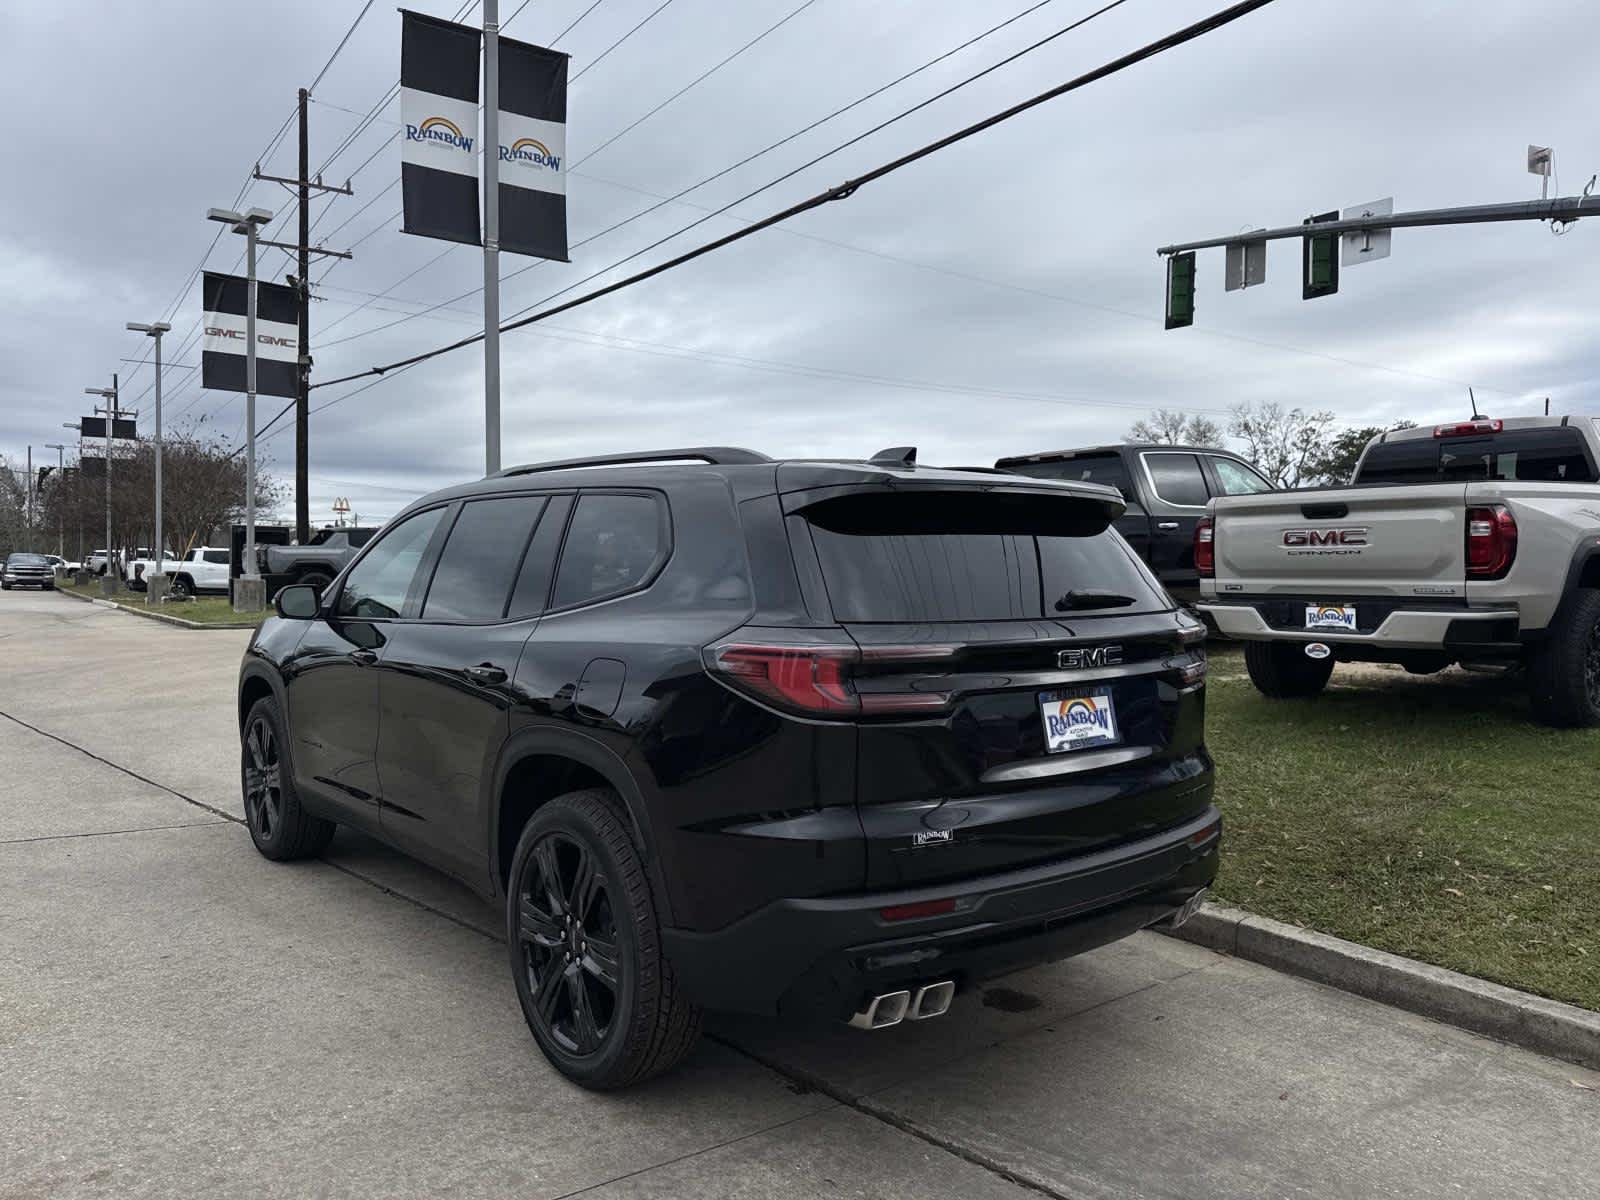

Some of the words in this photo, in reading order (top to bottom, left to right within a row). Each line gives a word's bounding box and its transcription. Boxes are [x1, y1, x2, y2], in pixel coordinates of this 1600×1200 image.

[406, 124, 474, 153] RAINBOW
[498, 145, 561, 172] RAINBOW
[204, 327, 246, 340] GMC
[257, 334, 297, 348] GMC
[1283, 528, 1368, 547] GMC
[1308, 612, 1354, 625] RAINBOW
[1057, 645, 1122, 669] GMC
[1047, 708, 1109, 738] RAINBOW
[917, 829, 950, 845] RAINBOW
